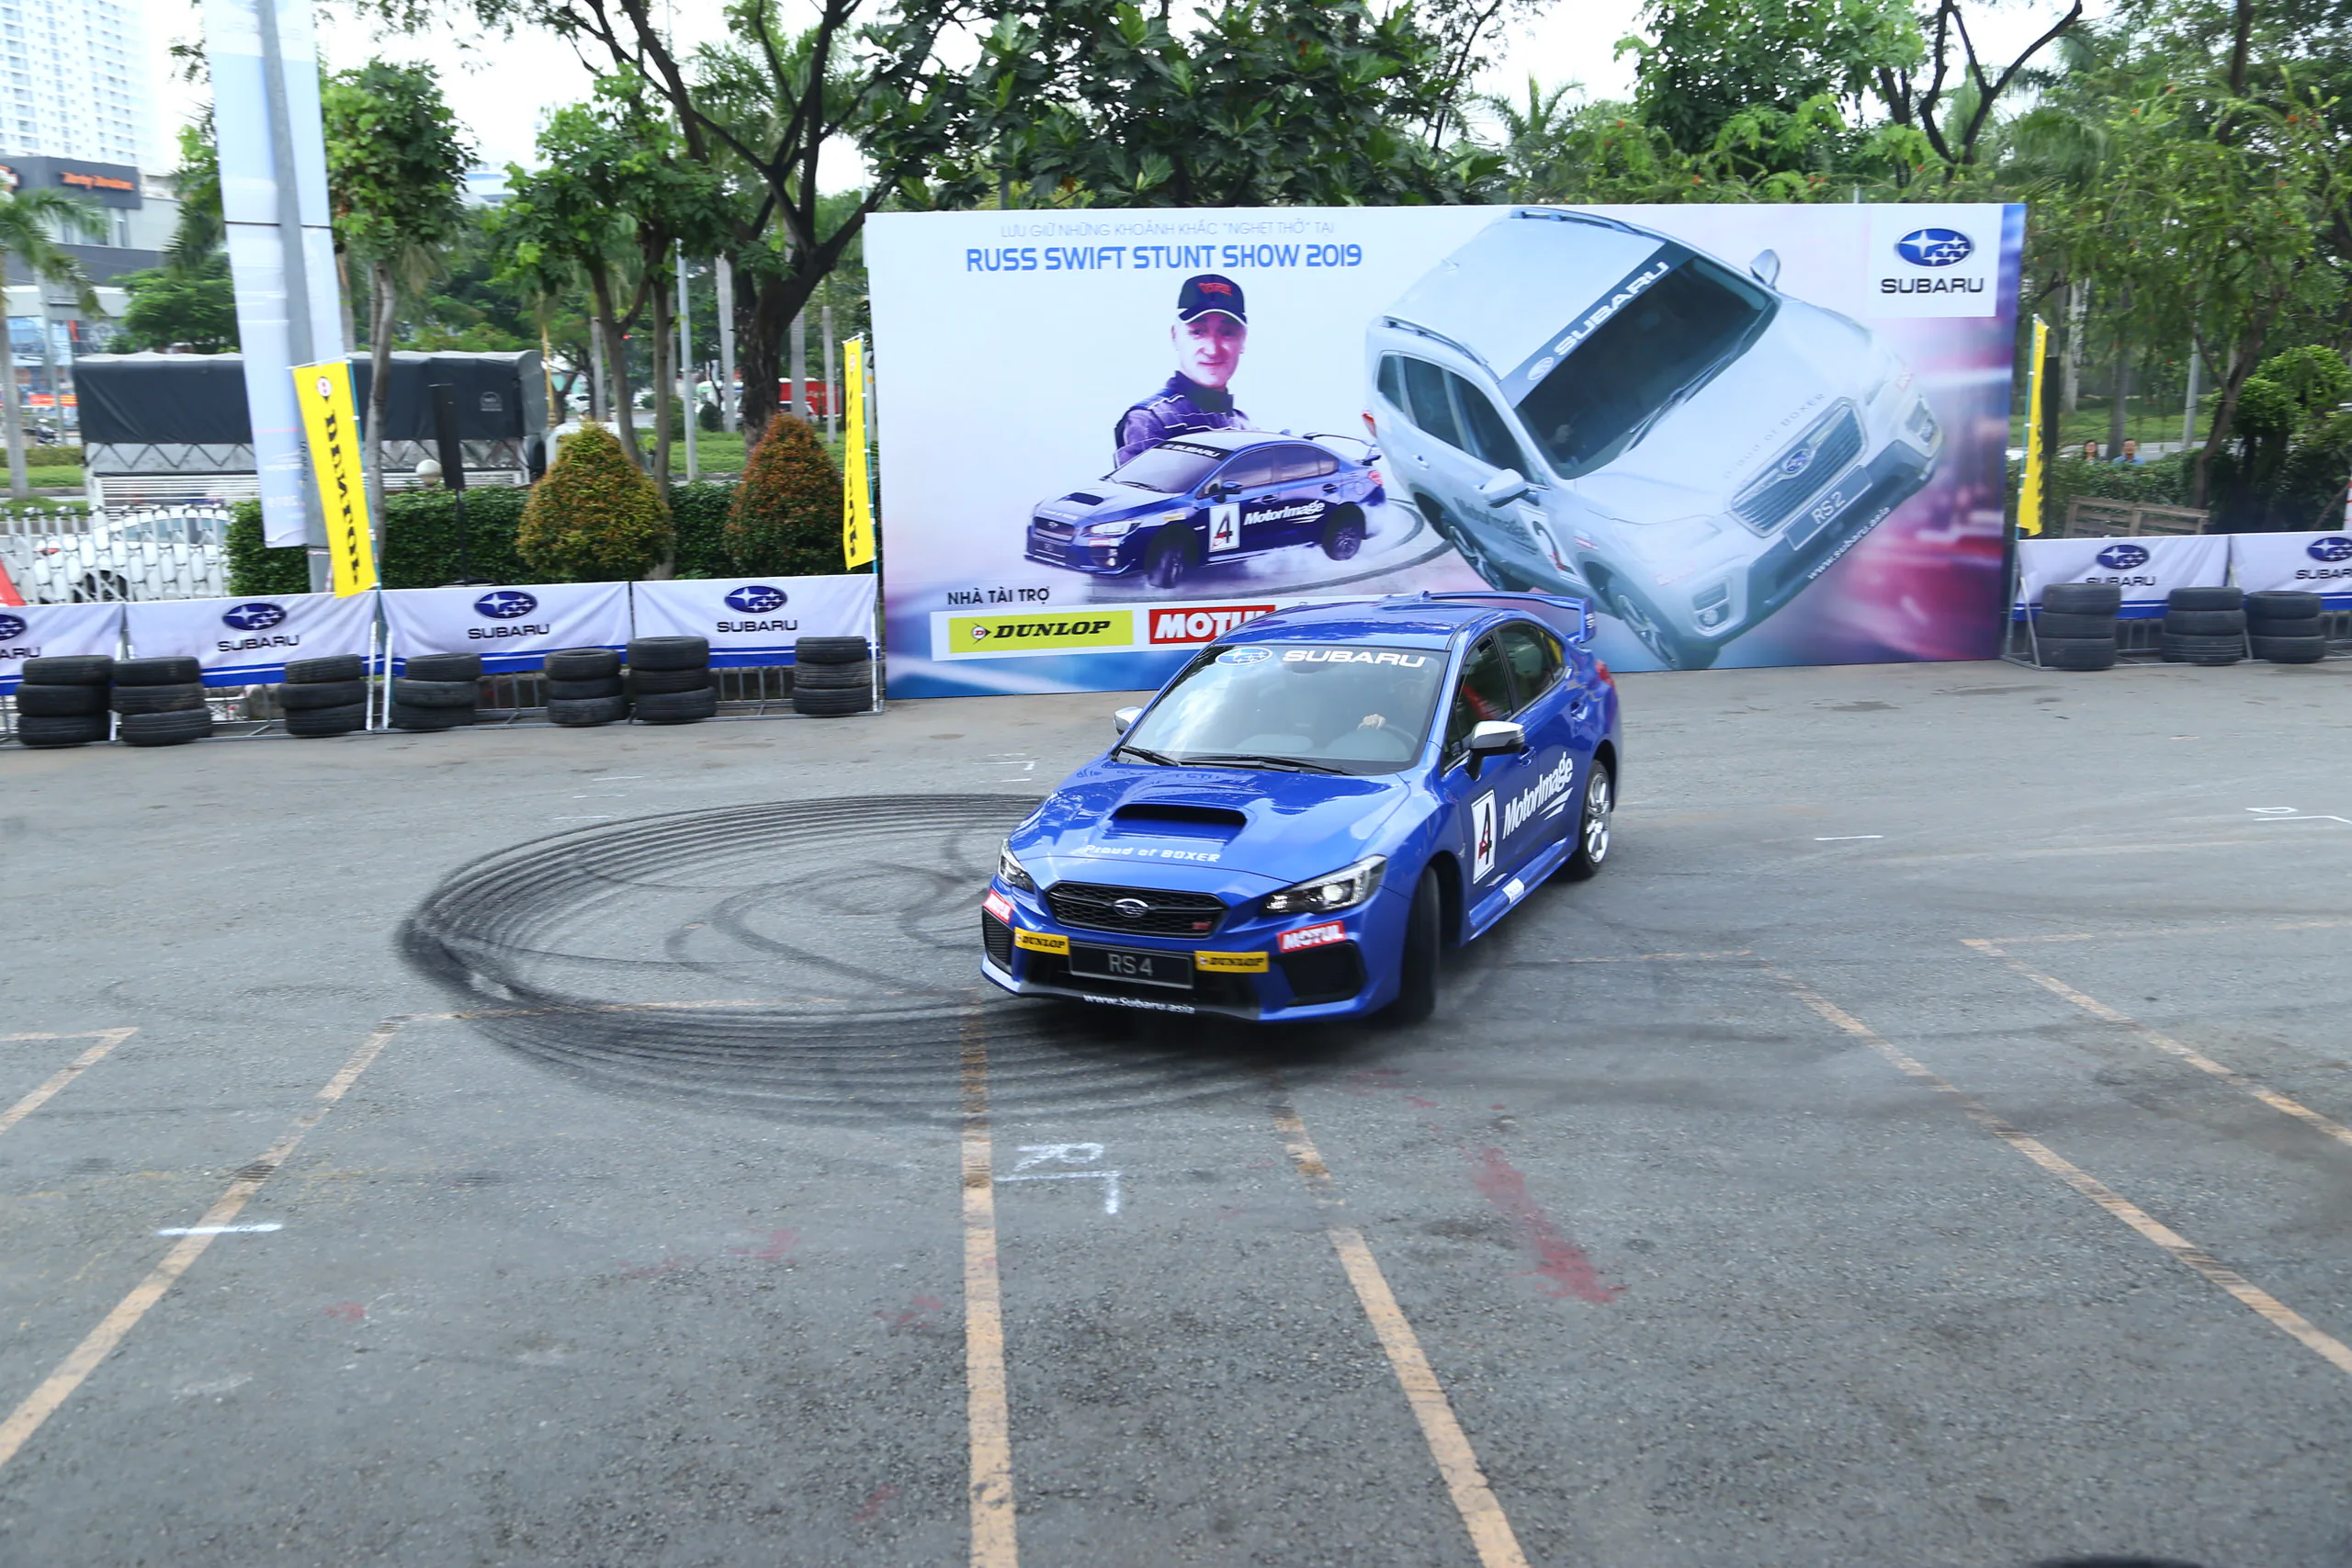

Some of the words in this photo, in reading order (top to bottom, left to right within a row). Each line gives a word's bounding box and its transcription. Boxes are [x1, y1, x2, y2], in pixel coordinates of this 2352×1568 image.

[967, 247, 1037, 272] RUSS
[1045, 246, 1126, 270] SWIFT
[1133, 245, 1216, 269] STUNT
[1222, 243, 1300, 268] SHOW
[1306, 243, 1363, 267] 2019
[1881, 277, 1984, 294] SUBARU
[1553, 261, 1670, 356] SUBARU
[1243, 500, 1326, 526] MotorImage
[1215, 510, 1234, 545] 4
[2295, 568, 2352, 580] SUBAR
[948, 590, 983, 605] NHÀ
[989, 589, 1013, 604] TÀI
[1018, 586, 1050, 605] TRỢ
[468, 623, 550, 640] SUBARU
[717, 618, 798, 634] SUBARU
[993, 620, 1111, 639] DUNLOP
[1154, 610, 1266, 640] MOT
[0, 646, 40, 660] ARU
[218, 634, 300, 652] SUBARU
[1283, 649, 1426, 669] SUBARU
[1502, 750, 1574, 840] MotorImage
[1477, 802, 1493, 866] 4
[1022, 935, 1066, 949] DUNLOP
[1282, 925, 1345, 951] MOTUL
[1107, 953, 1133, 975] RS
[1141, 957, 1154, 976] 4
